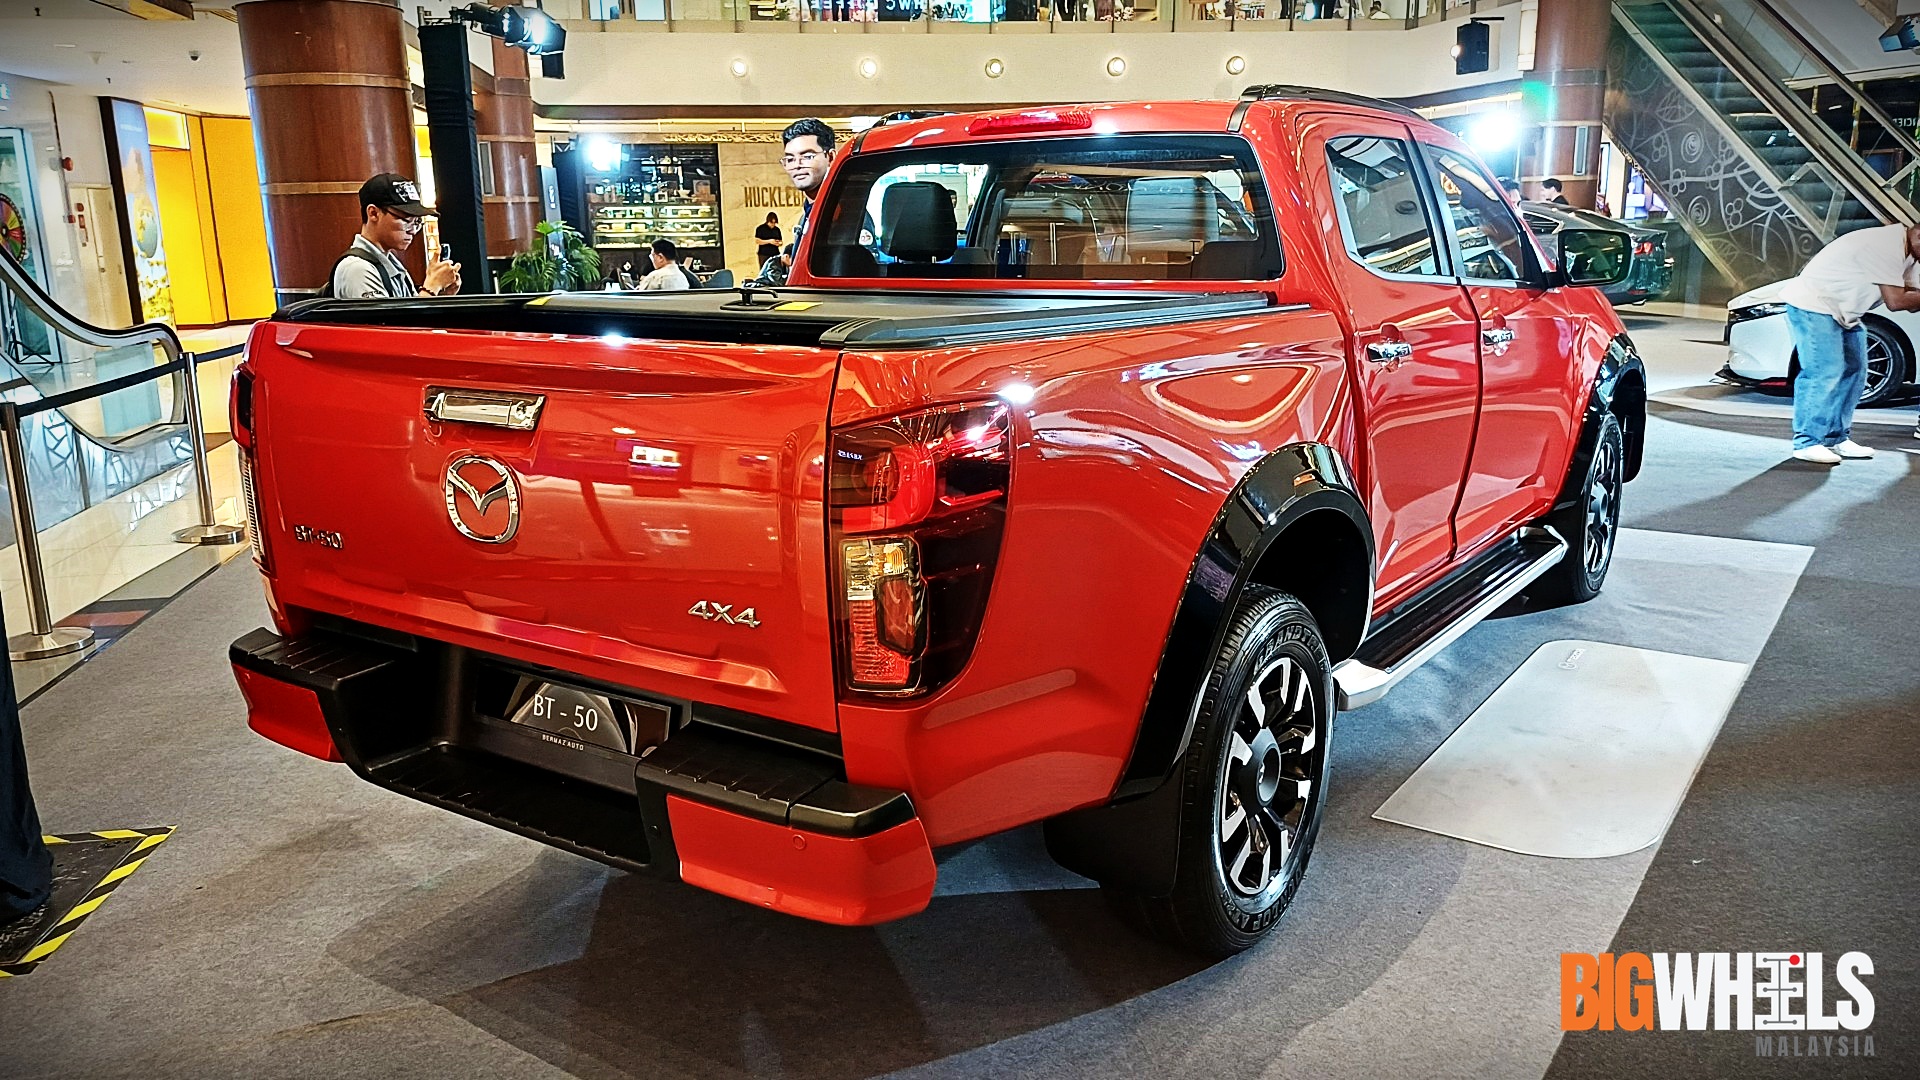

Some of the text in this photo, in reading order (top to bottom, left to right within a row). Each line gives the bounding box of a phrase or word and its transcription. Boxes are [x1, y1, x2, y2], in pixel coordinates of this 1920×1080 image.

[744, 186, 805, 207] HUCKLEB
[687, 599, 761, 629] 4X4
[533, 694, 555, 719] BT
[574, 705, 598, 731] 50
[542, 735, 584, 750] BERMAZ AUTO
